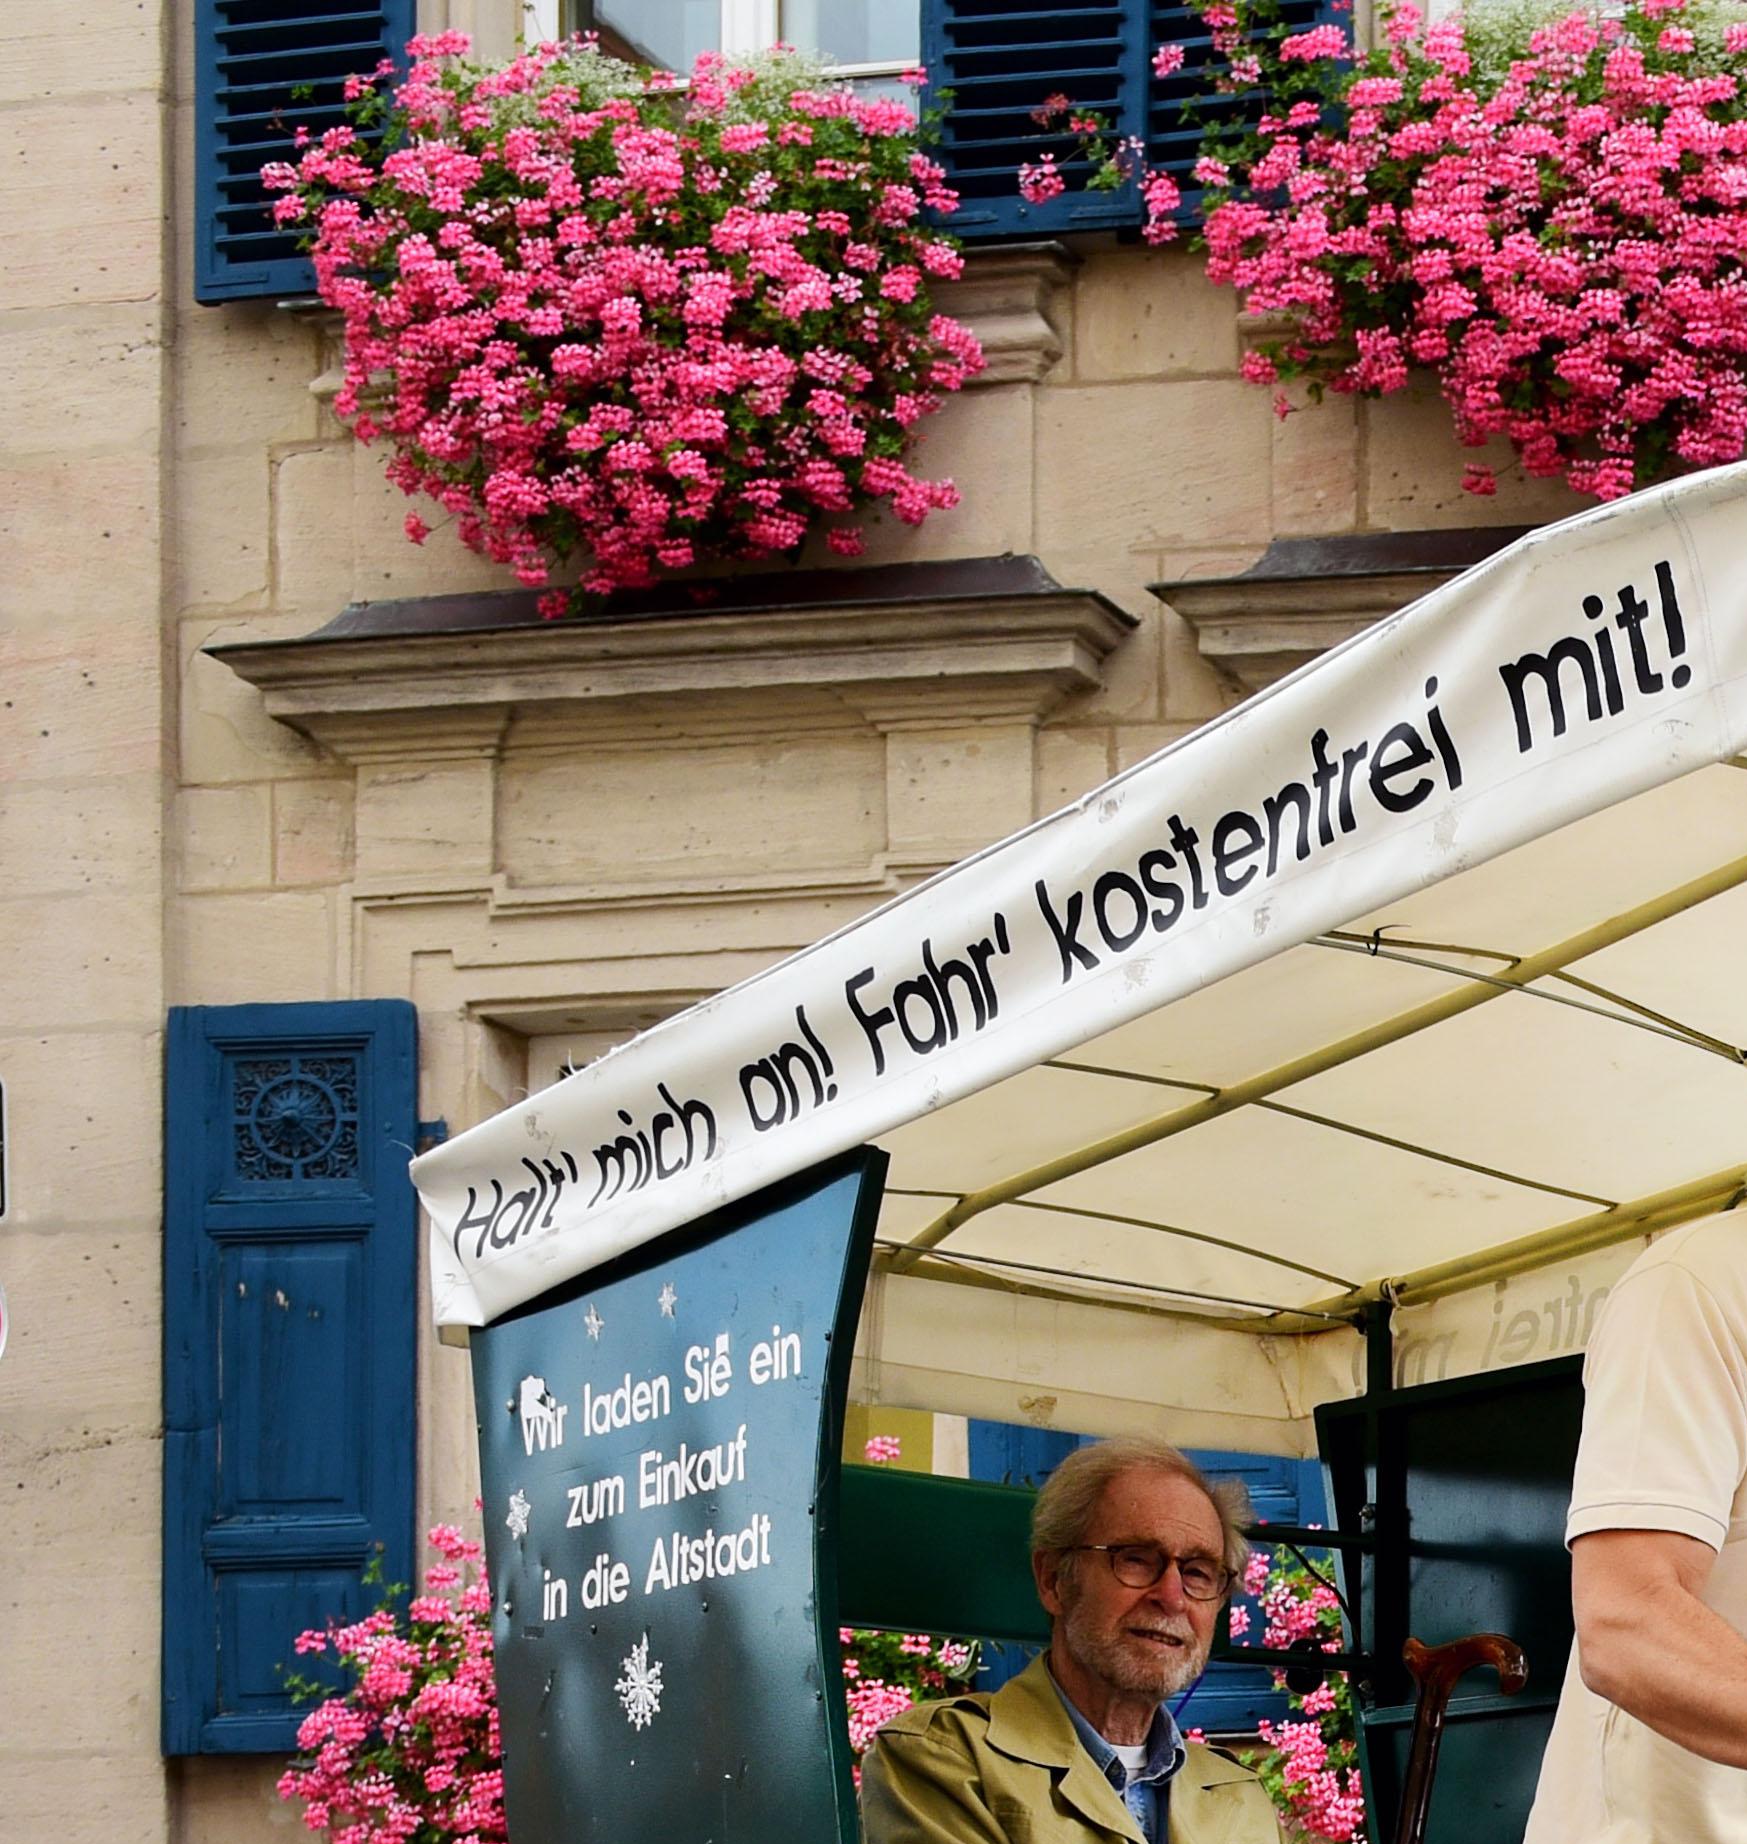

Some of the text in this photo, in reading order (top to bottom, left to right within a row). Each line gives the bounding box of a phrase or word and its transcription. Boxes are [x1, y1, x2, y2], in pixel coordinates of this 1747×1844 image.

[453, 561, 1691, 1258] Halt' mich an! Fahr' kostenfrei mit!
[583, 1372, 671, 1438] laden
[683, 1345, 733, 1404] Sie
[749, 1323, 802, 1386] ein
[565, 1423, 748, 1529] zum Einkauf
[543, 1512, 772, 1622] in die Altstadt
